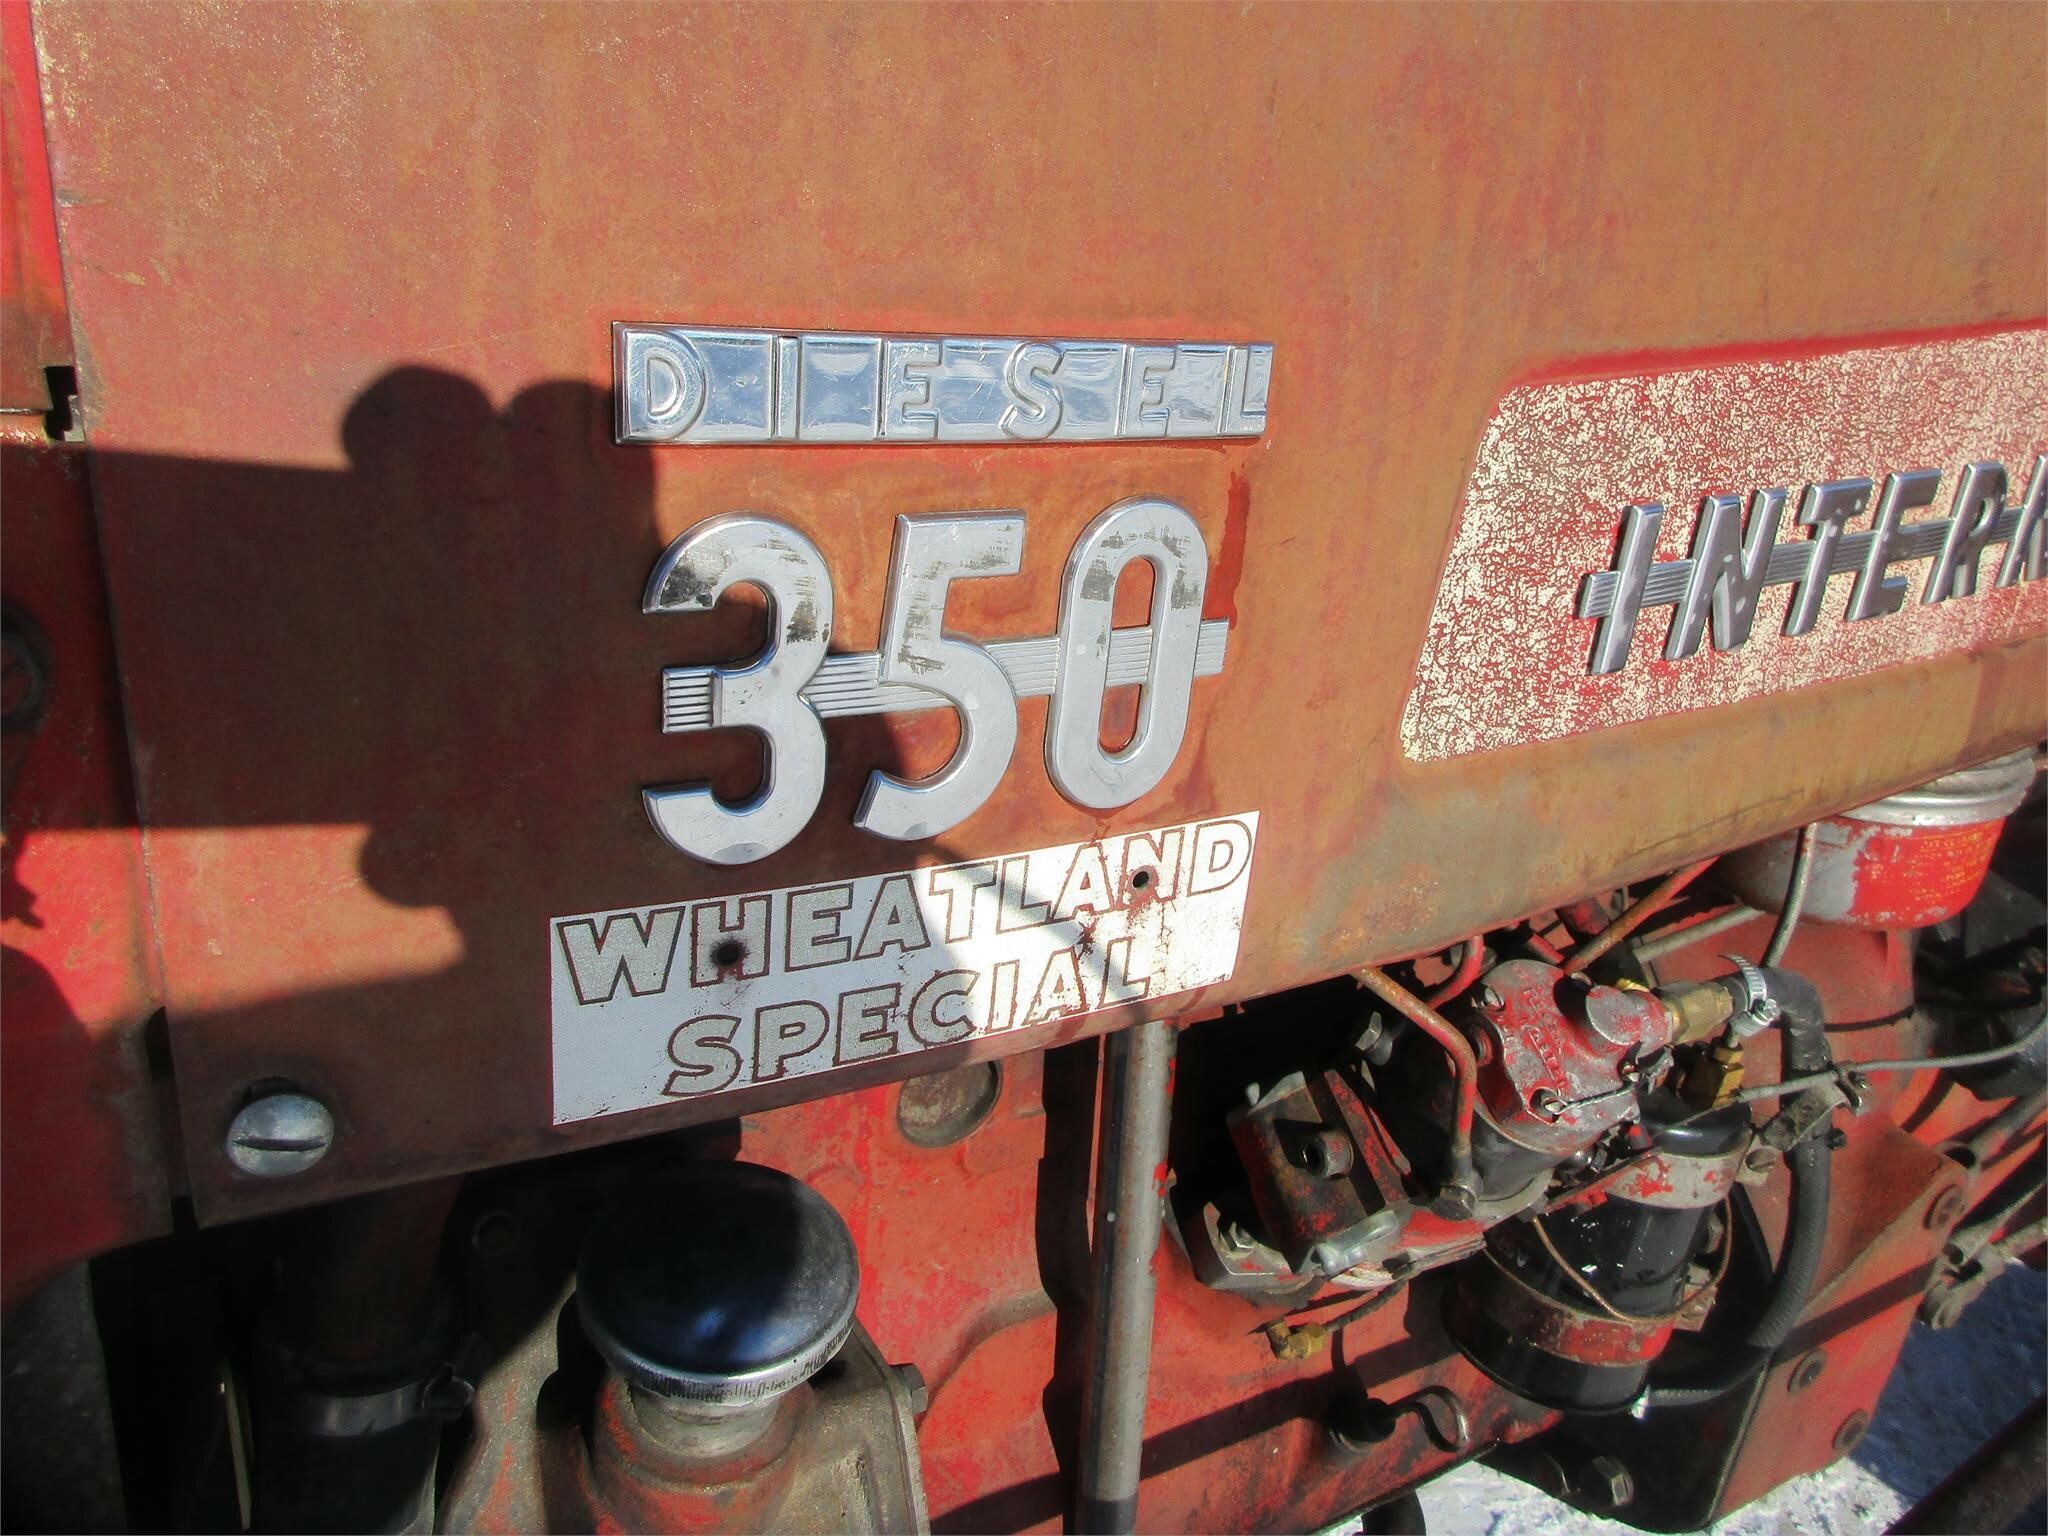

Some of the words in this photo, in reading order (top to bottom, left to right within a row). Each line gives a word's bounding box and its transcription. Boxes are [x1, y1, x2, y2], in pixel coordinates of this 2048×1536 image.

[621, 329, 1272, 440] DIESEL
[642, 494, 1208, 864] 350
[556, 819, 1253, 1006] WHEATLAND
[661, 936, 1152, 1097] SPECIAL
